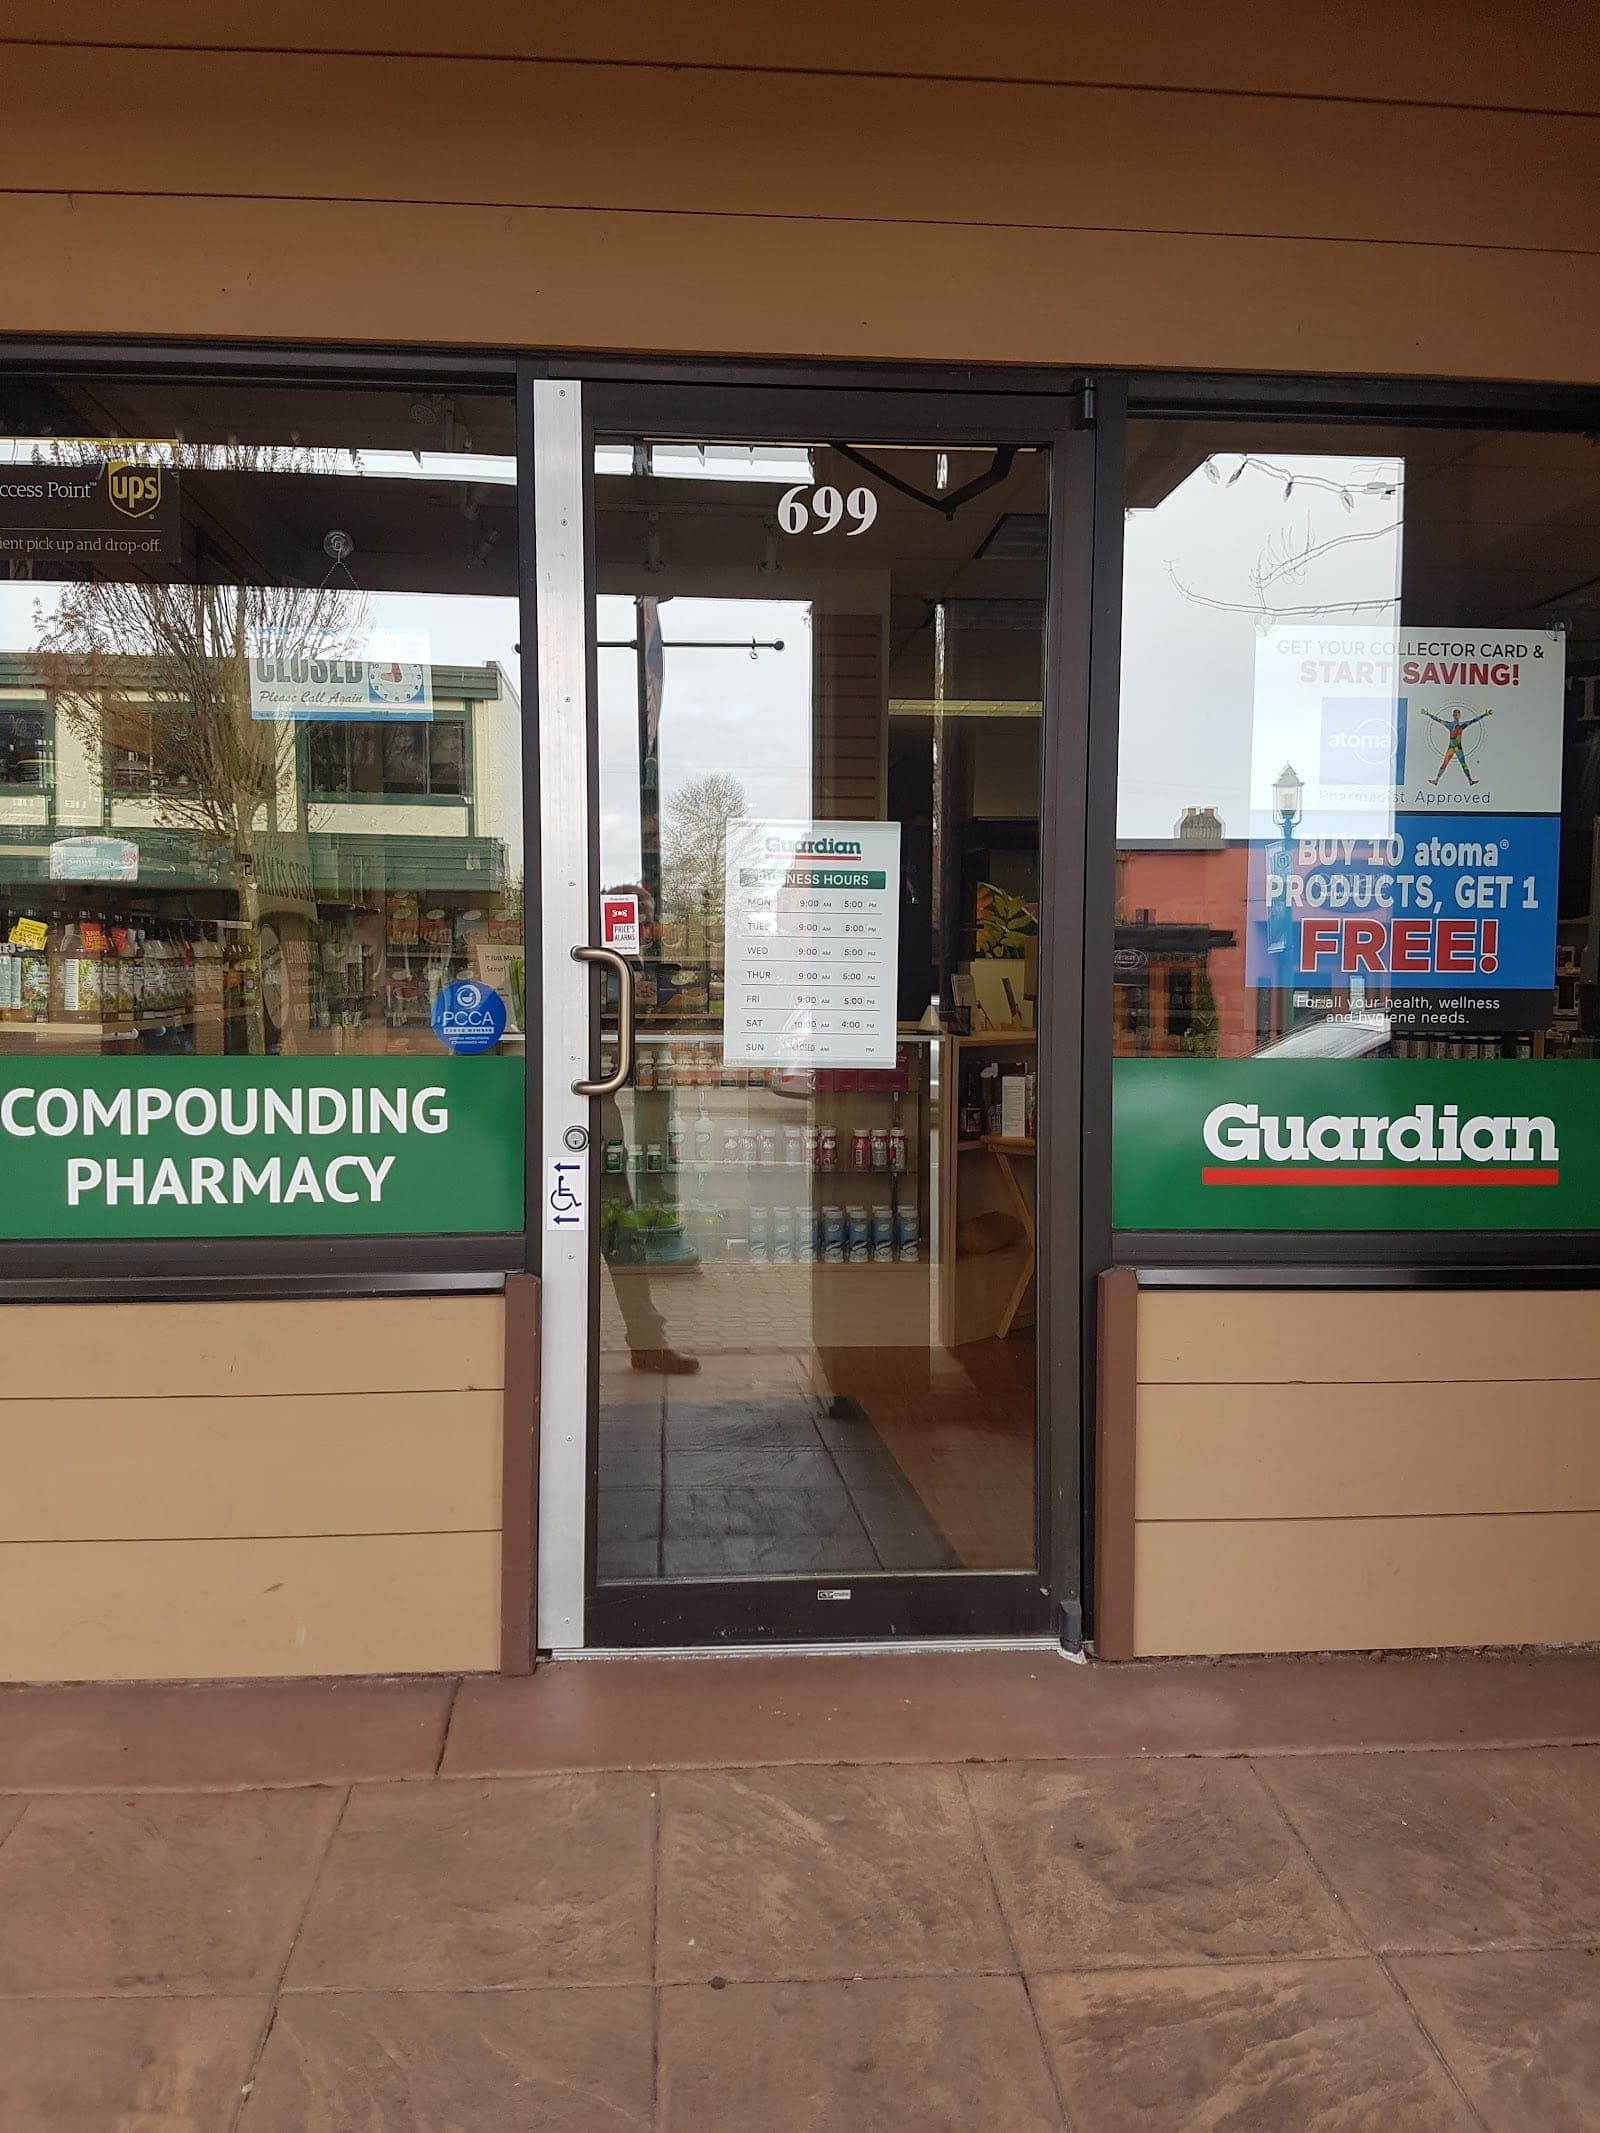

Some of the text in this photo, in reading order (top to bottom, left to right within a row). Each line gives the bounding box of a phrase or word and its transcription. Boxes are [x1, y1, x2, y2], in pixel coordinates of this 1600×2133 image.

[113, 476, 157, 508] ups
[778, 485, 877, 536] 699
[27, 536, 52, 552] pick
[56, 540, 73, 553] up
[76, 538, 101, 551] and
[103, 538, 162, 554] drop-off.
[1276, 640, 1544, 659] GET YOUR COLLECTOR CARD &
[256, 639, 363, 684] CLOSED
[1300, 660, 1520, 686] START SAVING!
[259, 690, 363, 706] Please Call Again
[1328, 730, 1391, 750] atoma
[1320, 790, 1491, 806] Pharmacist Approved
[765, 837, 861, 855] Guardian
[1298, 834, 1364, 866] BUY
[1368, 833, 1404, 867] 10
[823, 874, 869, 886] HOURS
[1265, 873, 1443, 914] PRODUCTS,
[1455, 875, 1513, 909] GET
[1522, 876, 1538, 909] 1
[748, 898, 771, 906] MON
[800, 899, 819, 908] 9:00
[844, 900, 863, 908] 5:00
[748, 923, 769, 931] TUES
[798, 923, 818, 932] 9:00
[845, 924, 864, 932] 5:00
[747, 946, 769, 955] WED
[798, 948, 818, 956] 9:00
[844, 948, 863, 957] 5:00
[1300, 917, 1499, 974] FREE!
[747, 971, 771, 979] THUR
[798, 972, 818, 980] 9:00
[746, 995, 760, 1003] FRI
[797, 996, 817, 1004] 9:00
[844, 997, 863, 1005] 5:00
[1296, 995, 1500, 1012] For all your health, wellness
[442, 1011, 495, 1026] PCCA
[746, 1019, 763, 1027] SAT
[841, 1021, 861, 1029] 4:00
[1326, 1010, 1469, 1027] and hygiene needs.
[746, 1043, 765, 1051] SUN
[2, 1087, 449, 1137] COMPOUNDING
[1203, 1102, 1559, 1161] Guardian
[67, 1155, 396, 1206] PHARMACY
